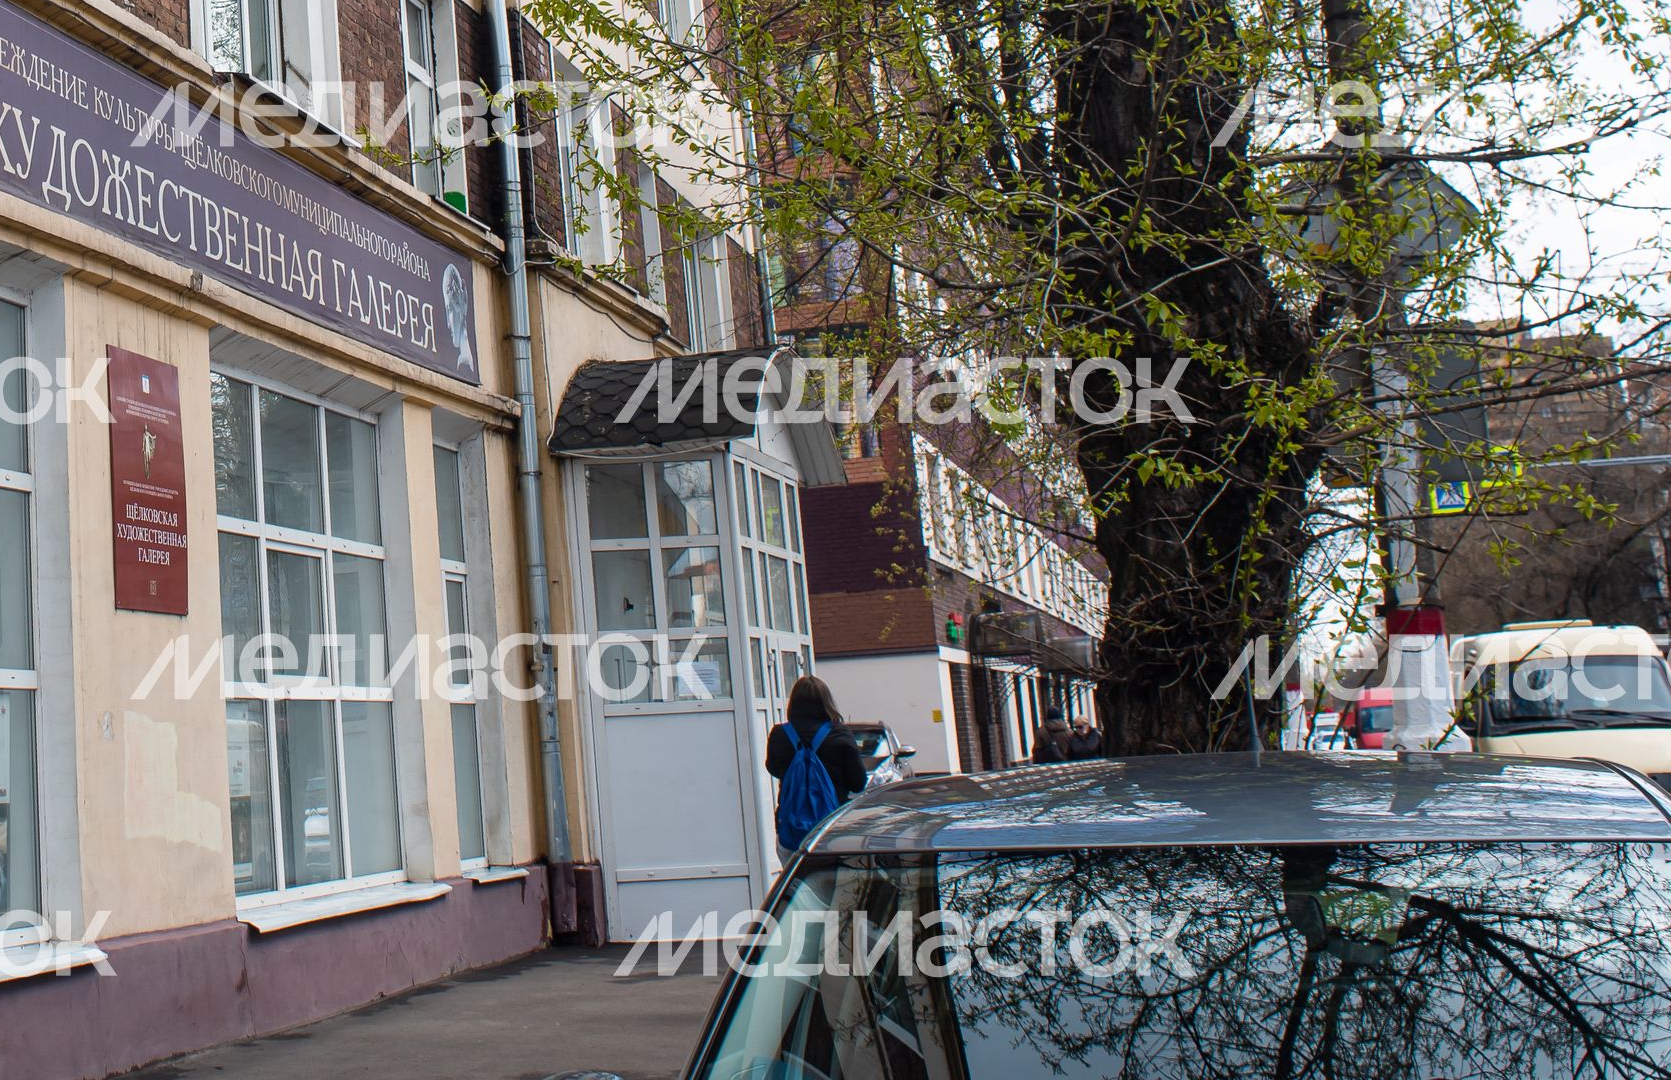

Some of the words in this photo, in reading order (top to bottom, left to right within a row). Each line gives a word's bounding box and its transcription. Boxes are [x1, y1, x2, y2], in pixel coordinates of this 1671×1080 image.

[93, 86, 177, 154] КУЛЬТУРЫ
[332, 258, 438, 353] ГАЛЕРЕЯ
[126, 502, 178, 527] ЩЁЛКОВСКАЯ
[117, 522, 187, 548] ХУДОЖЕСТВЕННАЯ
[138, 547, 170, 566] ГАЛЕРЕЯ
